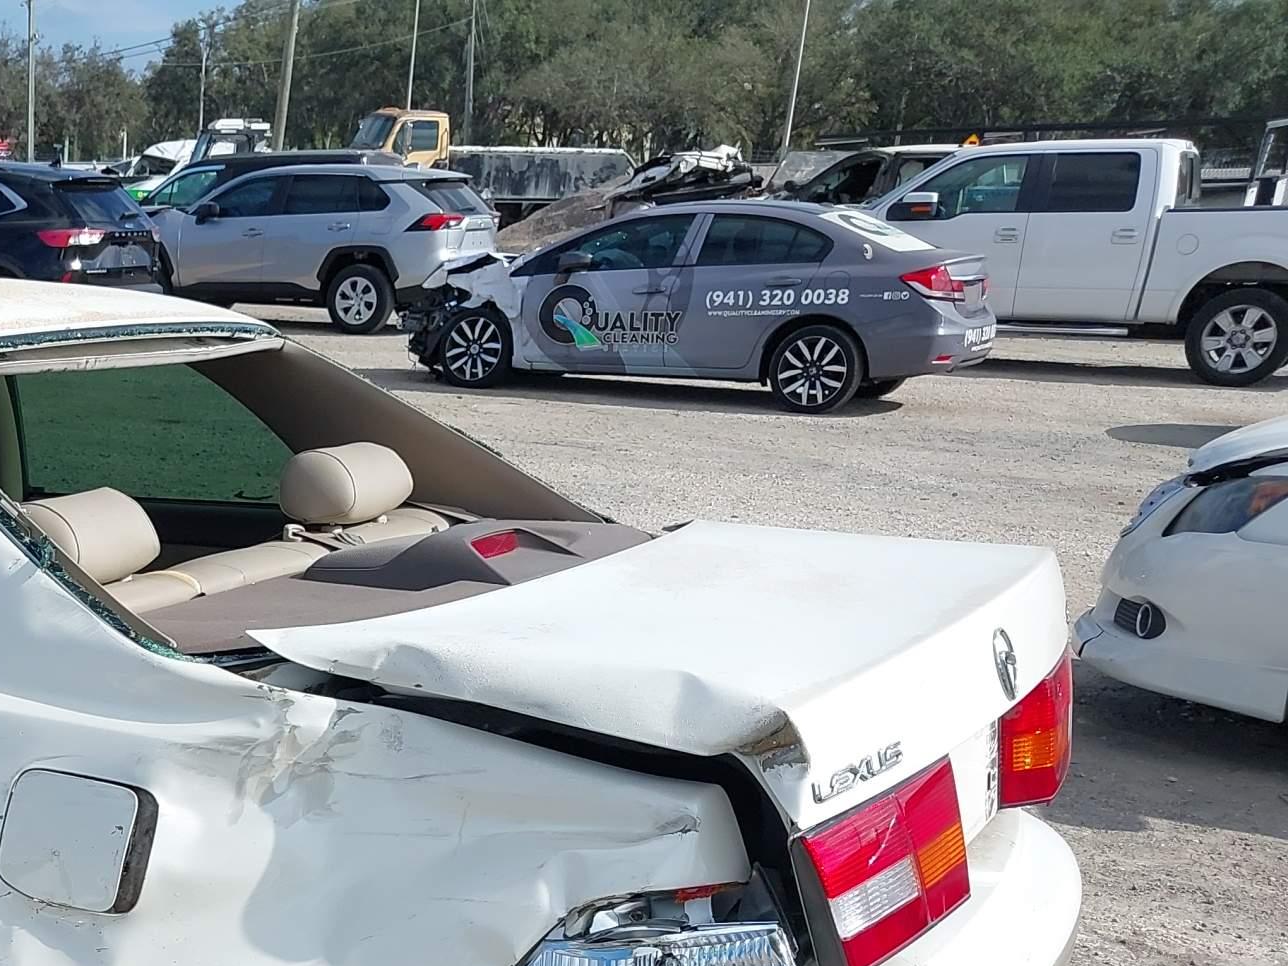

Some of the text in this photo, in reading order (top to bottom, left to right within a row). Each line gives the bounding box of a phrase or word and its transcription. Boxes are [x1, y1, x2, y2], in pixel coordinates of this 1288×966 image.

[538, 284, 682, 345] QUALITY
[705, 288, 850, 309] (941) 320 0038
[602, 331, 680, 345] CLEANING
[811, 740, 904, 804] LEXUS
